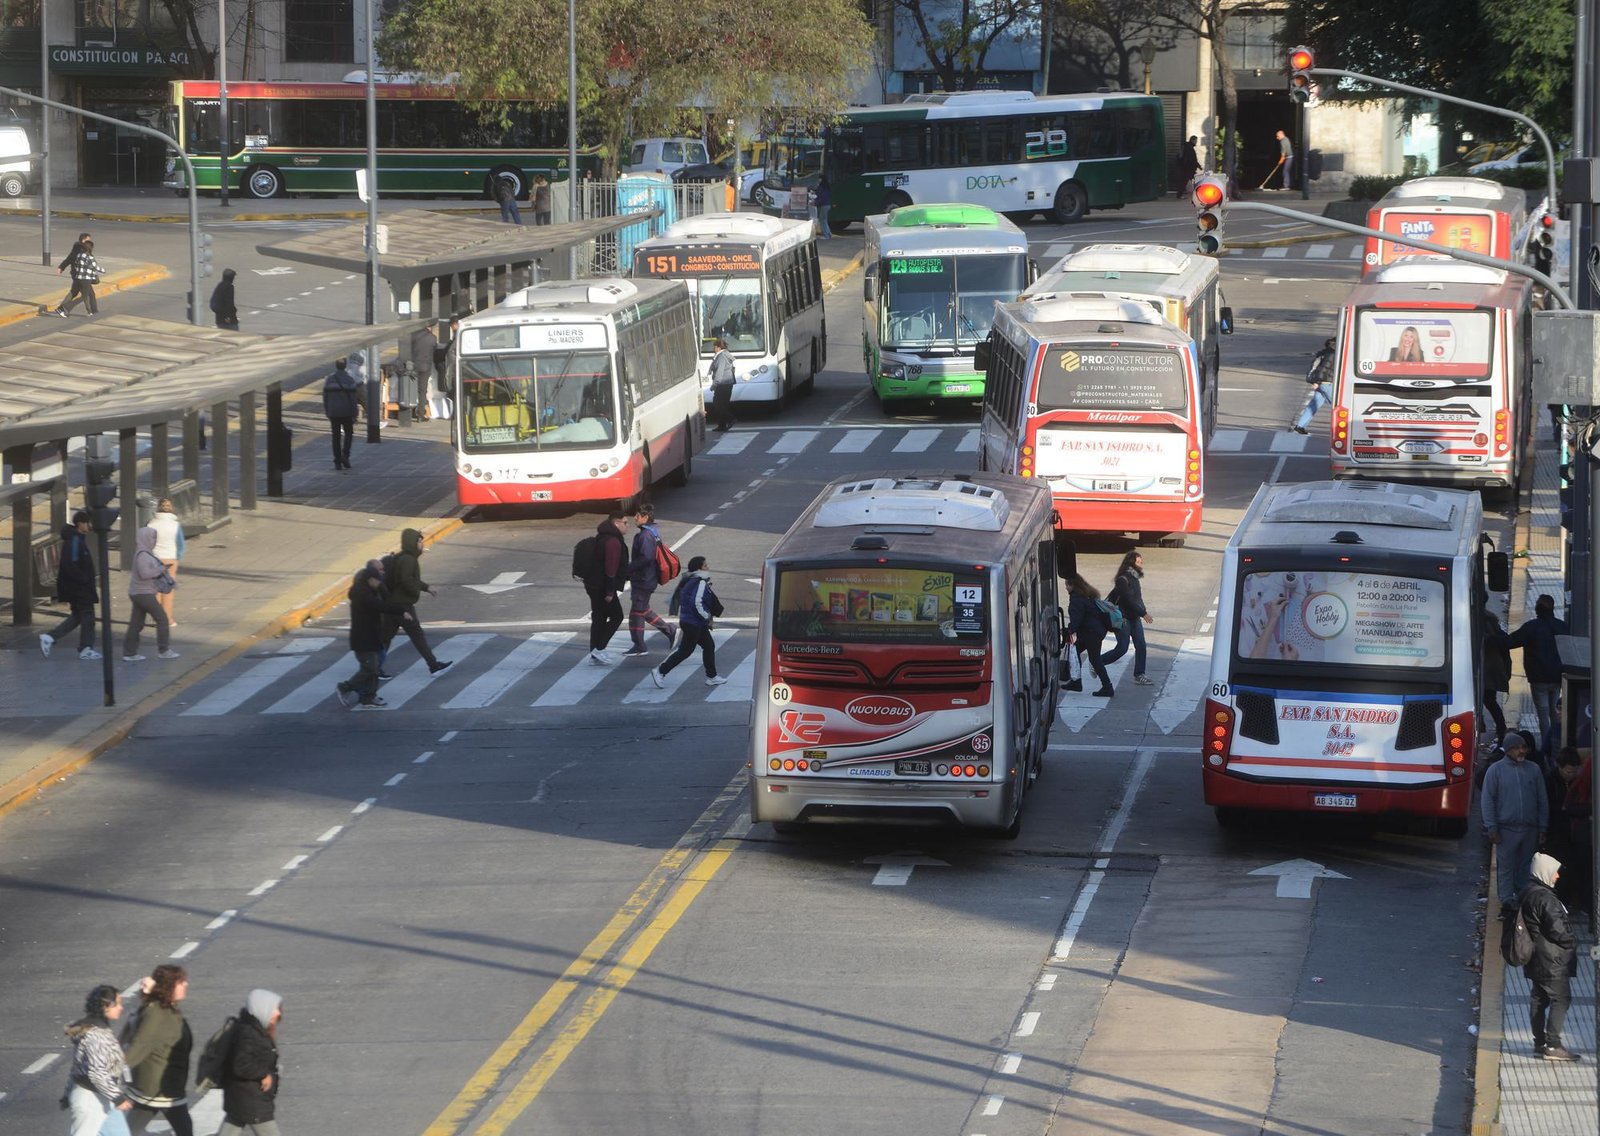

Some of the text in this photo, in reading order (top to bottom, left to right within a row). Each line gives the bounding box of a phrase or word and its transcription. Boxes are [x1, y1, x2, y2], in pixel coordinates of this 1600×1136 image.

[53, 50, 138, 64] CONSTITUCION
[1025, 130, 1067, 160] 28
[966, 175, 1005, 190] DOTA
[647, 255, 678, 274] 151
[688, 255, 727, 264] SAAVEDRA
[733, 255, 753, 263] ONCE
[908, 258, 942, 266] AUTOPISTA
[681, 263, 713, 272] CONGRESO
[718, 262, 760, 271] CONSTITUCION
[890, 259, 907, 274] 129
[548, 328, 584, 337] LINIERS
[560, 335, 584, 344] MADERO
[1081, 355, 1174, 366] PROCONSTRUCTOR
[1362, 361, 1373, 371] 60
[1081, 364, 1089, 372] EL
[1087, 412, 1143, 423] Metalpar
[1357, 580, 1363, 588] 4
[1372, 580, 1379, 588] 6
[1380, 581, 1391, 589] de
[1392, 581, 1421, 590] ABRIL
[962, 589, 976, 600] 12
[1357, 591, 1380, 601] 12:00
[1389, 592, 1415, 602] 20:00
[1416, 593, 1427, 603] hs
[963, 608, 975, 617] 35
[1314, 604, 1333, 616] Expo
[1316, 612, 1340, 625] Hobby
[1355, 620, 1396, 628] MEGASHOW
[1406, 622, 1425, 630] ARTE
[1361, 629, 1424, 639] MANUALIDADES
[781, 644, 840, 655] Mercedes-Benz
[773, 687, 789, 701] 60
[1212, 683, 1228, 698] 60
[849, 704, 912, 717] NUOVOBUS
[1278, 705, 1400, 725] EXP. SAN ISIDRO
[778, 708, 827, 745] 12
[1326, 723, 1356, 740] S.A.
[974, 737, 990, 753] 35
[1321, 740, 1356, 757] 3042
[849, 768, 892, 777] CLIMABUS
[914, 764, 928, 773] 476
[1316, 796, 1326, 806] AB
